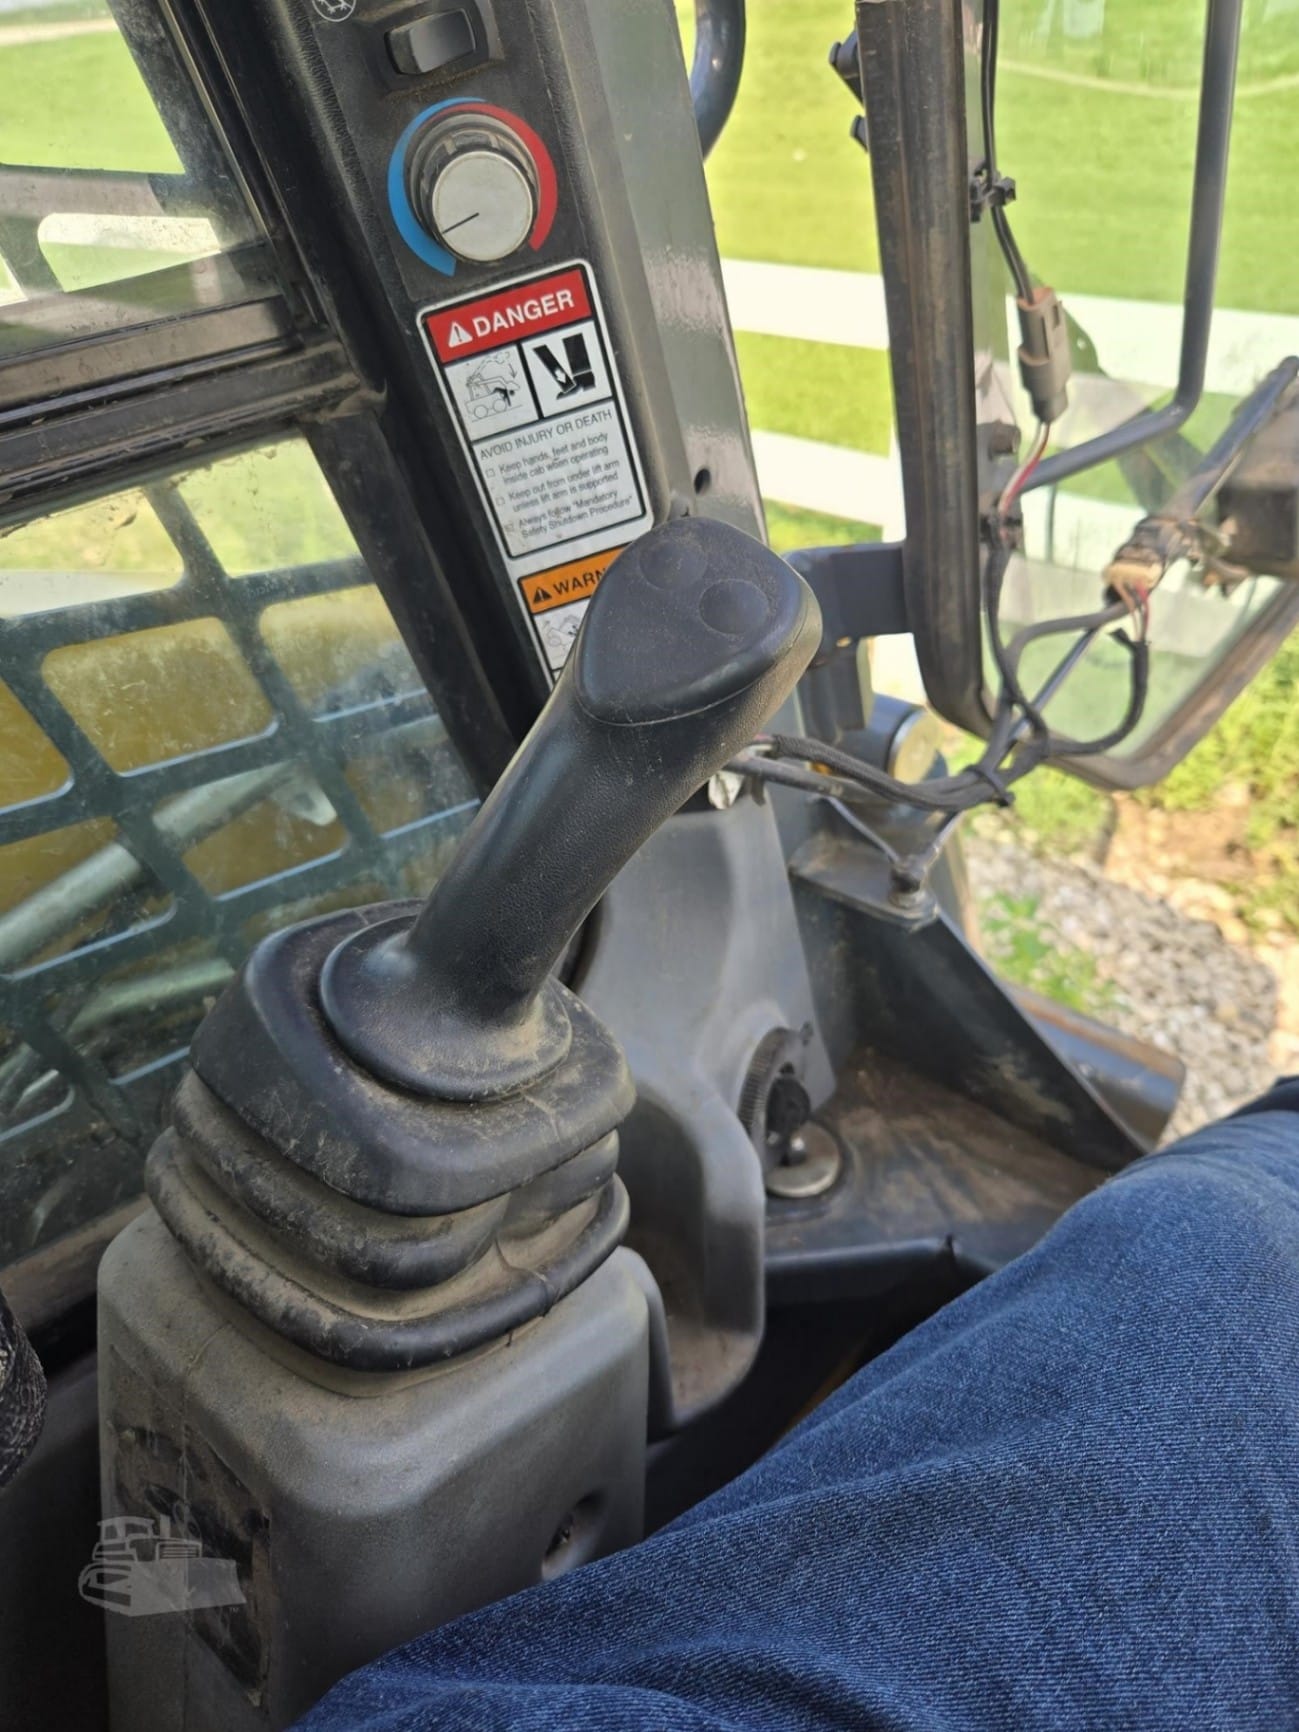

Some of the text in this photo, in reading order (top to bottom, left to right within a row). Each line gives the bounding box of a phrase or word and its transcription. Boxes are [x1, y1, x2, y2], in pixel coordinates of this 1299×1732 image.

[472, 289, 575, 338] DANGER
[480, 409, 612, 460] AVOID INJURY OR DEATH
[499, 460, 522, 473] Keep
[552, 446, 568, 457] feet
[571, 440, 587, 452] and
[588, 432, 608, 446] body
[508, 460, 620, 501] Keep out from under lift arm
[530, 467, 545, 477] cab
[547, 458, 568, 471] when
[570, 446, 609, 464] operating
[513, 472, 618, 512] unless lift arm is supported
[519, 513, 547, 528] Always
[521, 524, 547, 538] Safety
[549, 513, 588, 529] Shutdown
[553, 568, 607, 595] WARN
